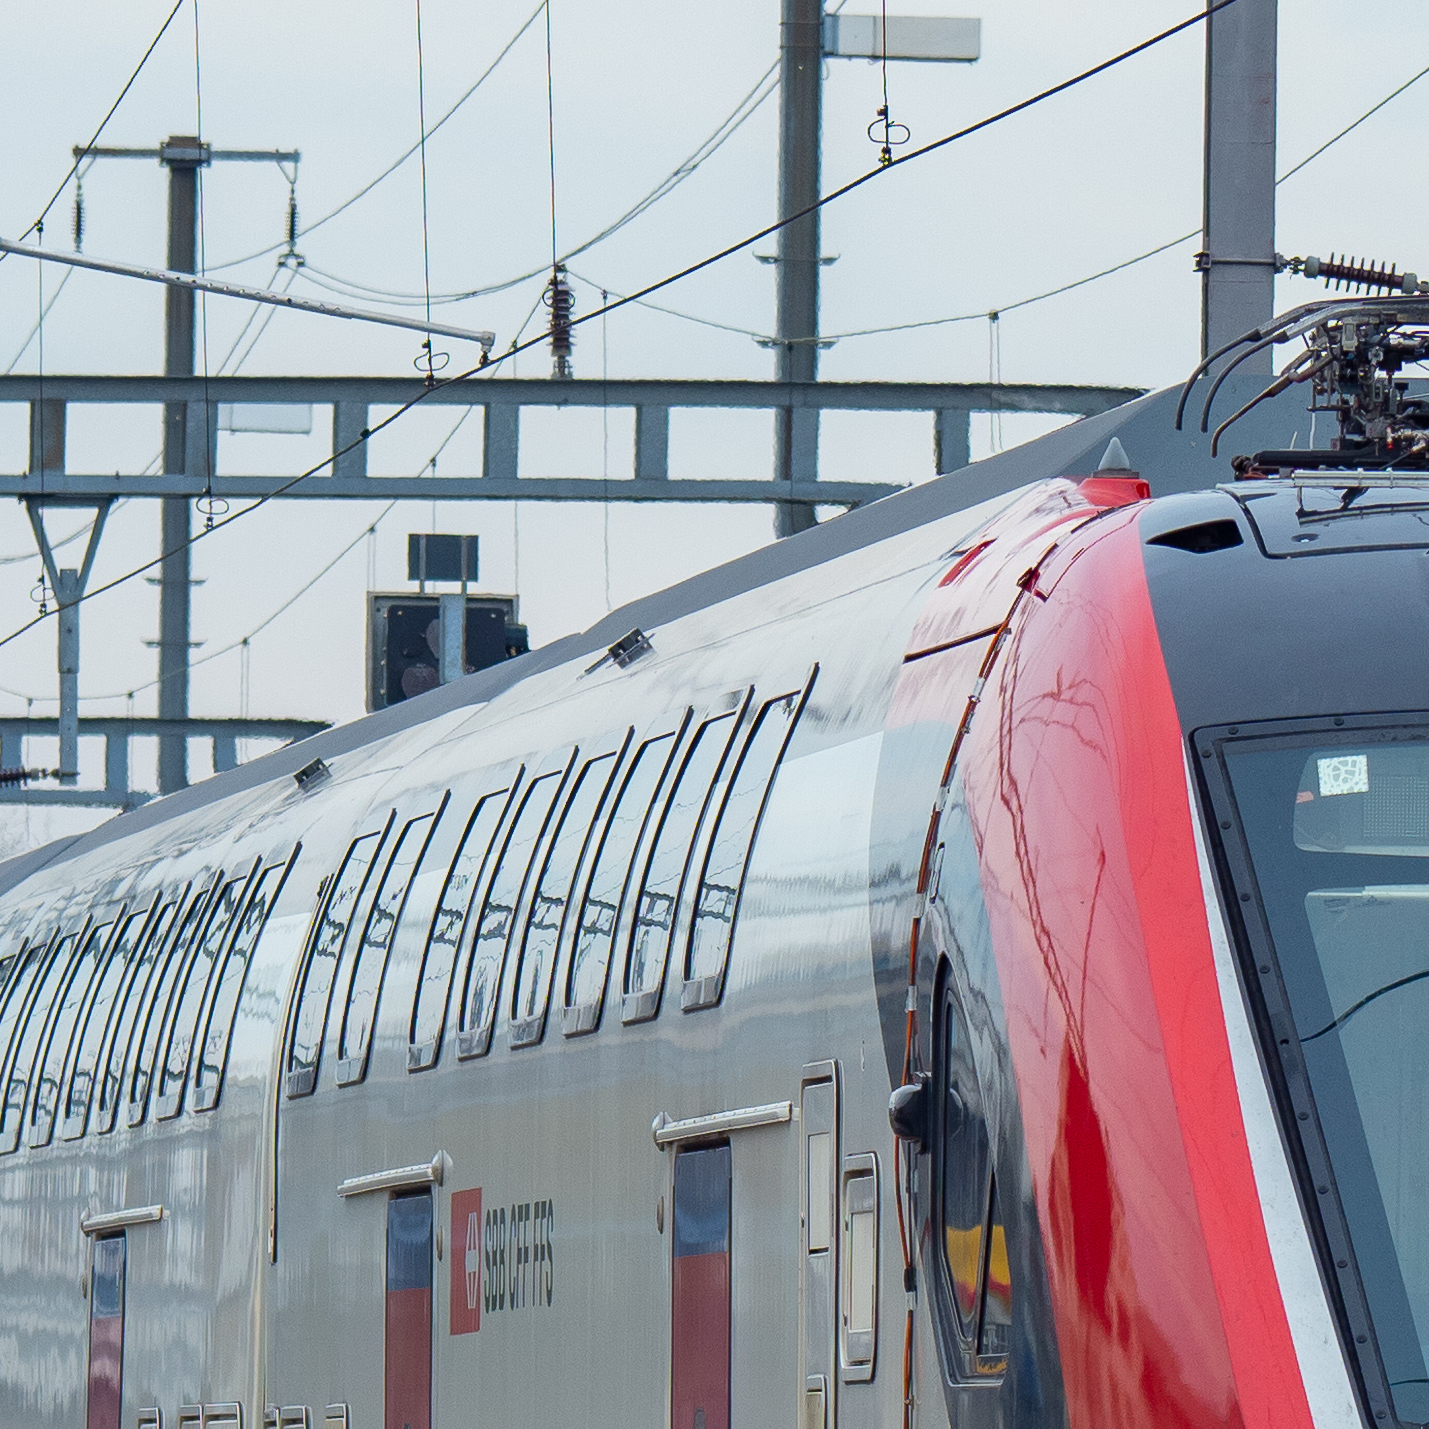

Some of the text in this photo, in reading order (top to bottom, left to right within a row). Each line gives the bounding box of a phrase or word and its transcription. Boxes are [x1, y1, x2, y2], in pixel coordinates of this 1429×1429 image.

[484, 1198, 554, 1314] SBB CFF FFS
